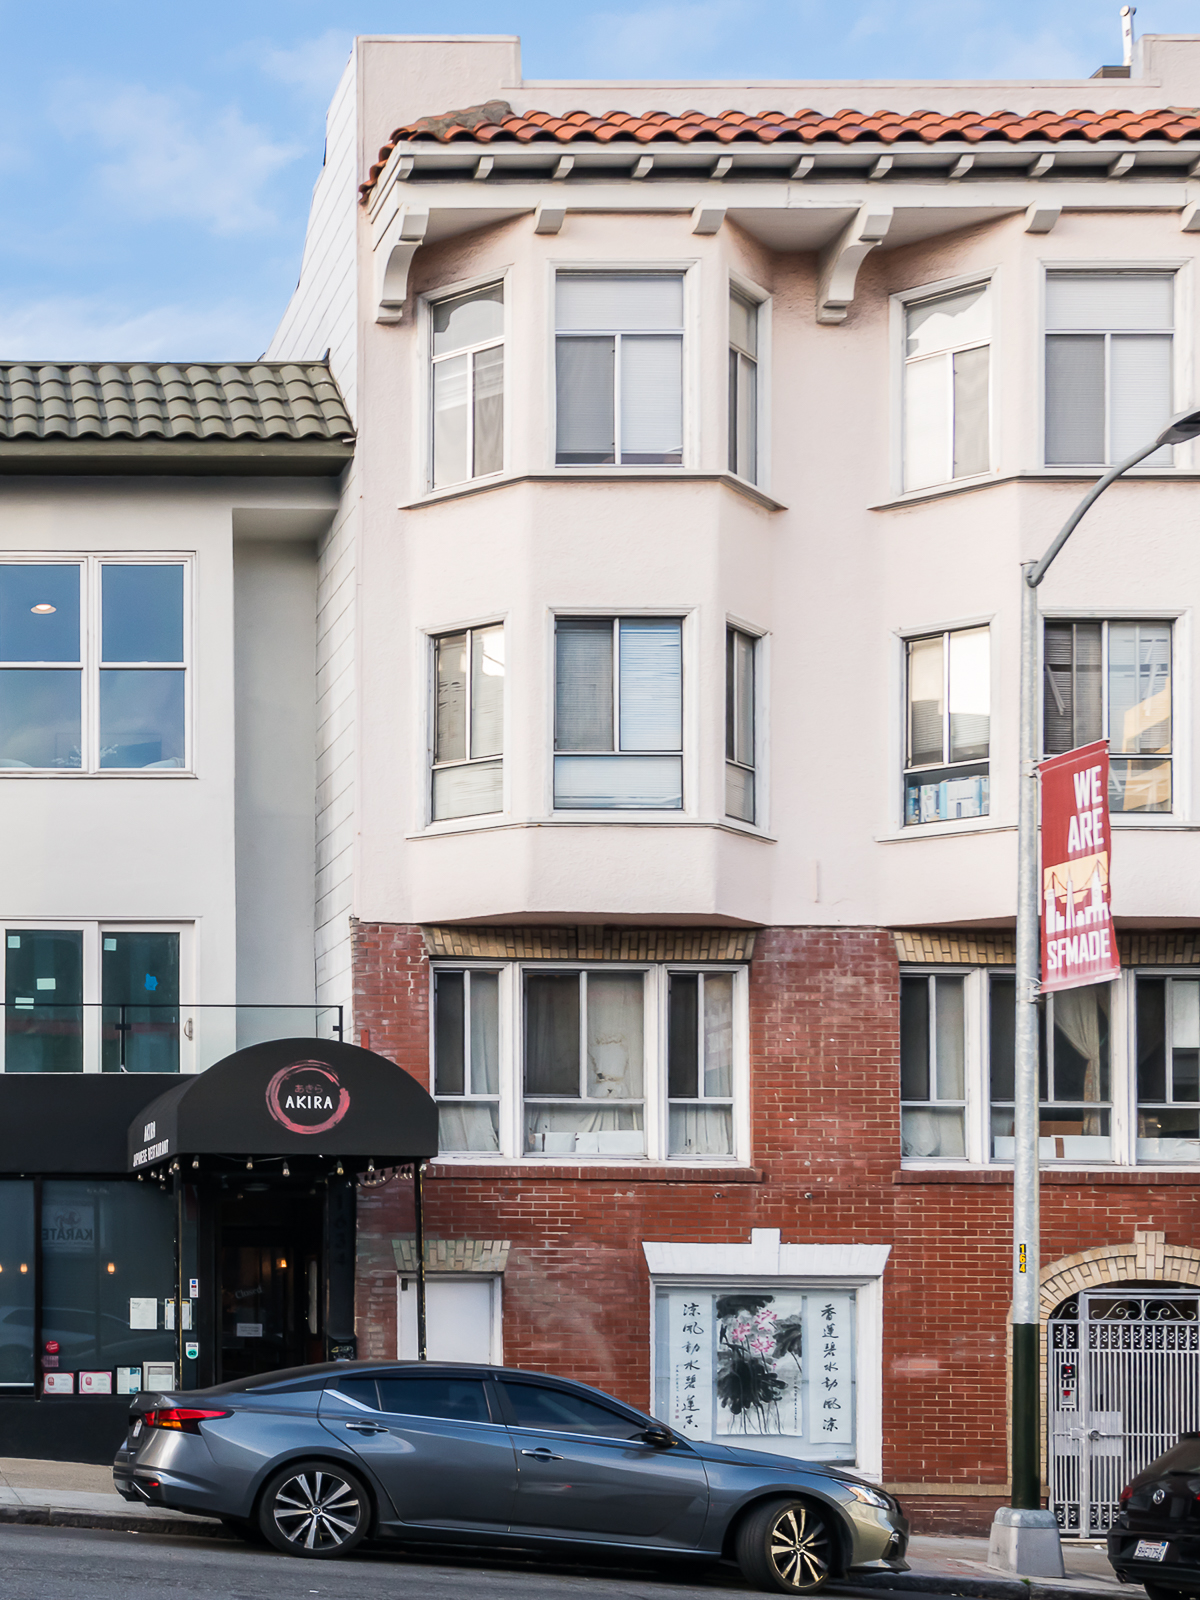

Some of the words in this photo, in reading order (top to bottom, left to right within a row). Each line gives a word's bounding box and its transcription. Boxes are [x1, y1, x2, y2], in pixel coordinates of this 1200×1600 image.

[1073, 765, 1103, 809] WE
[1068, 806, 1105, 853] ARE
[1046, 928, 1111, 970] SFMADE
[285, 1095, 333, 1109] AKIRA
[294, 1084, 324, 1094] あきら
[235, 1285, 263, 1299] Closed
